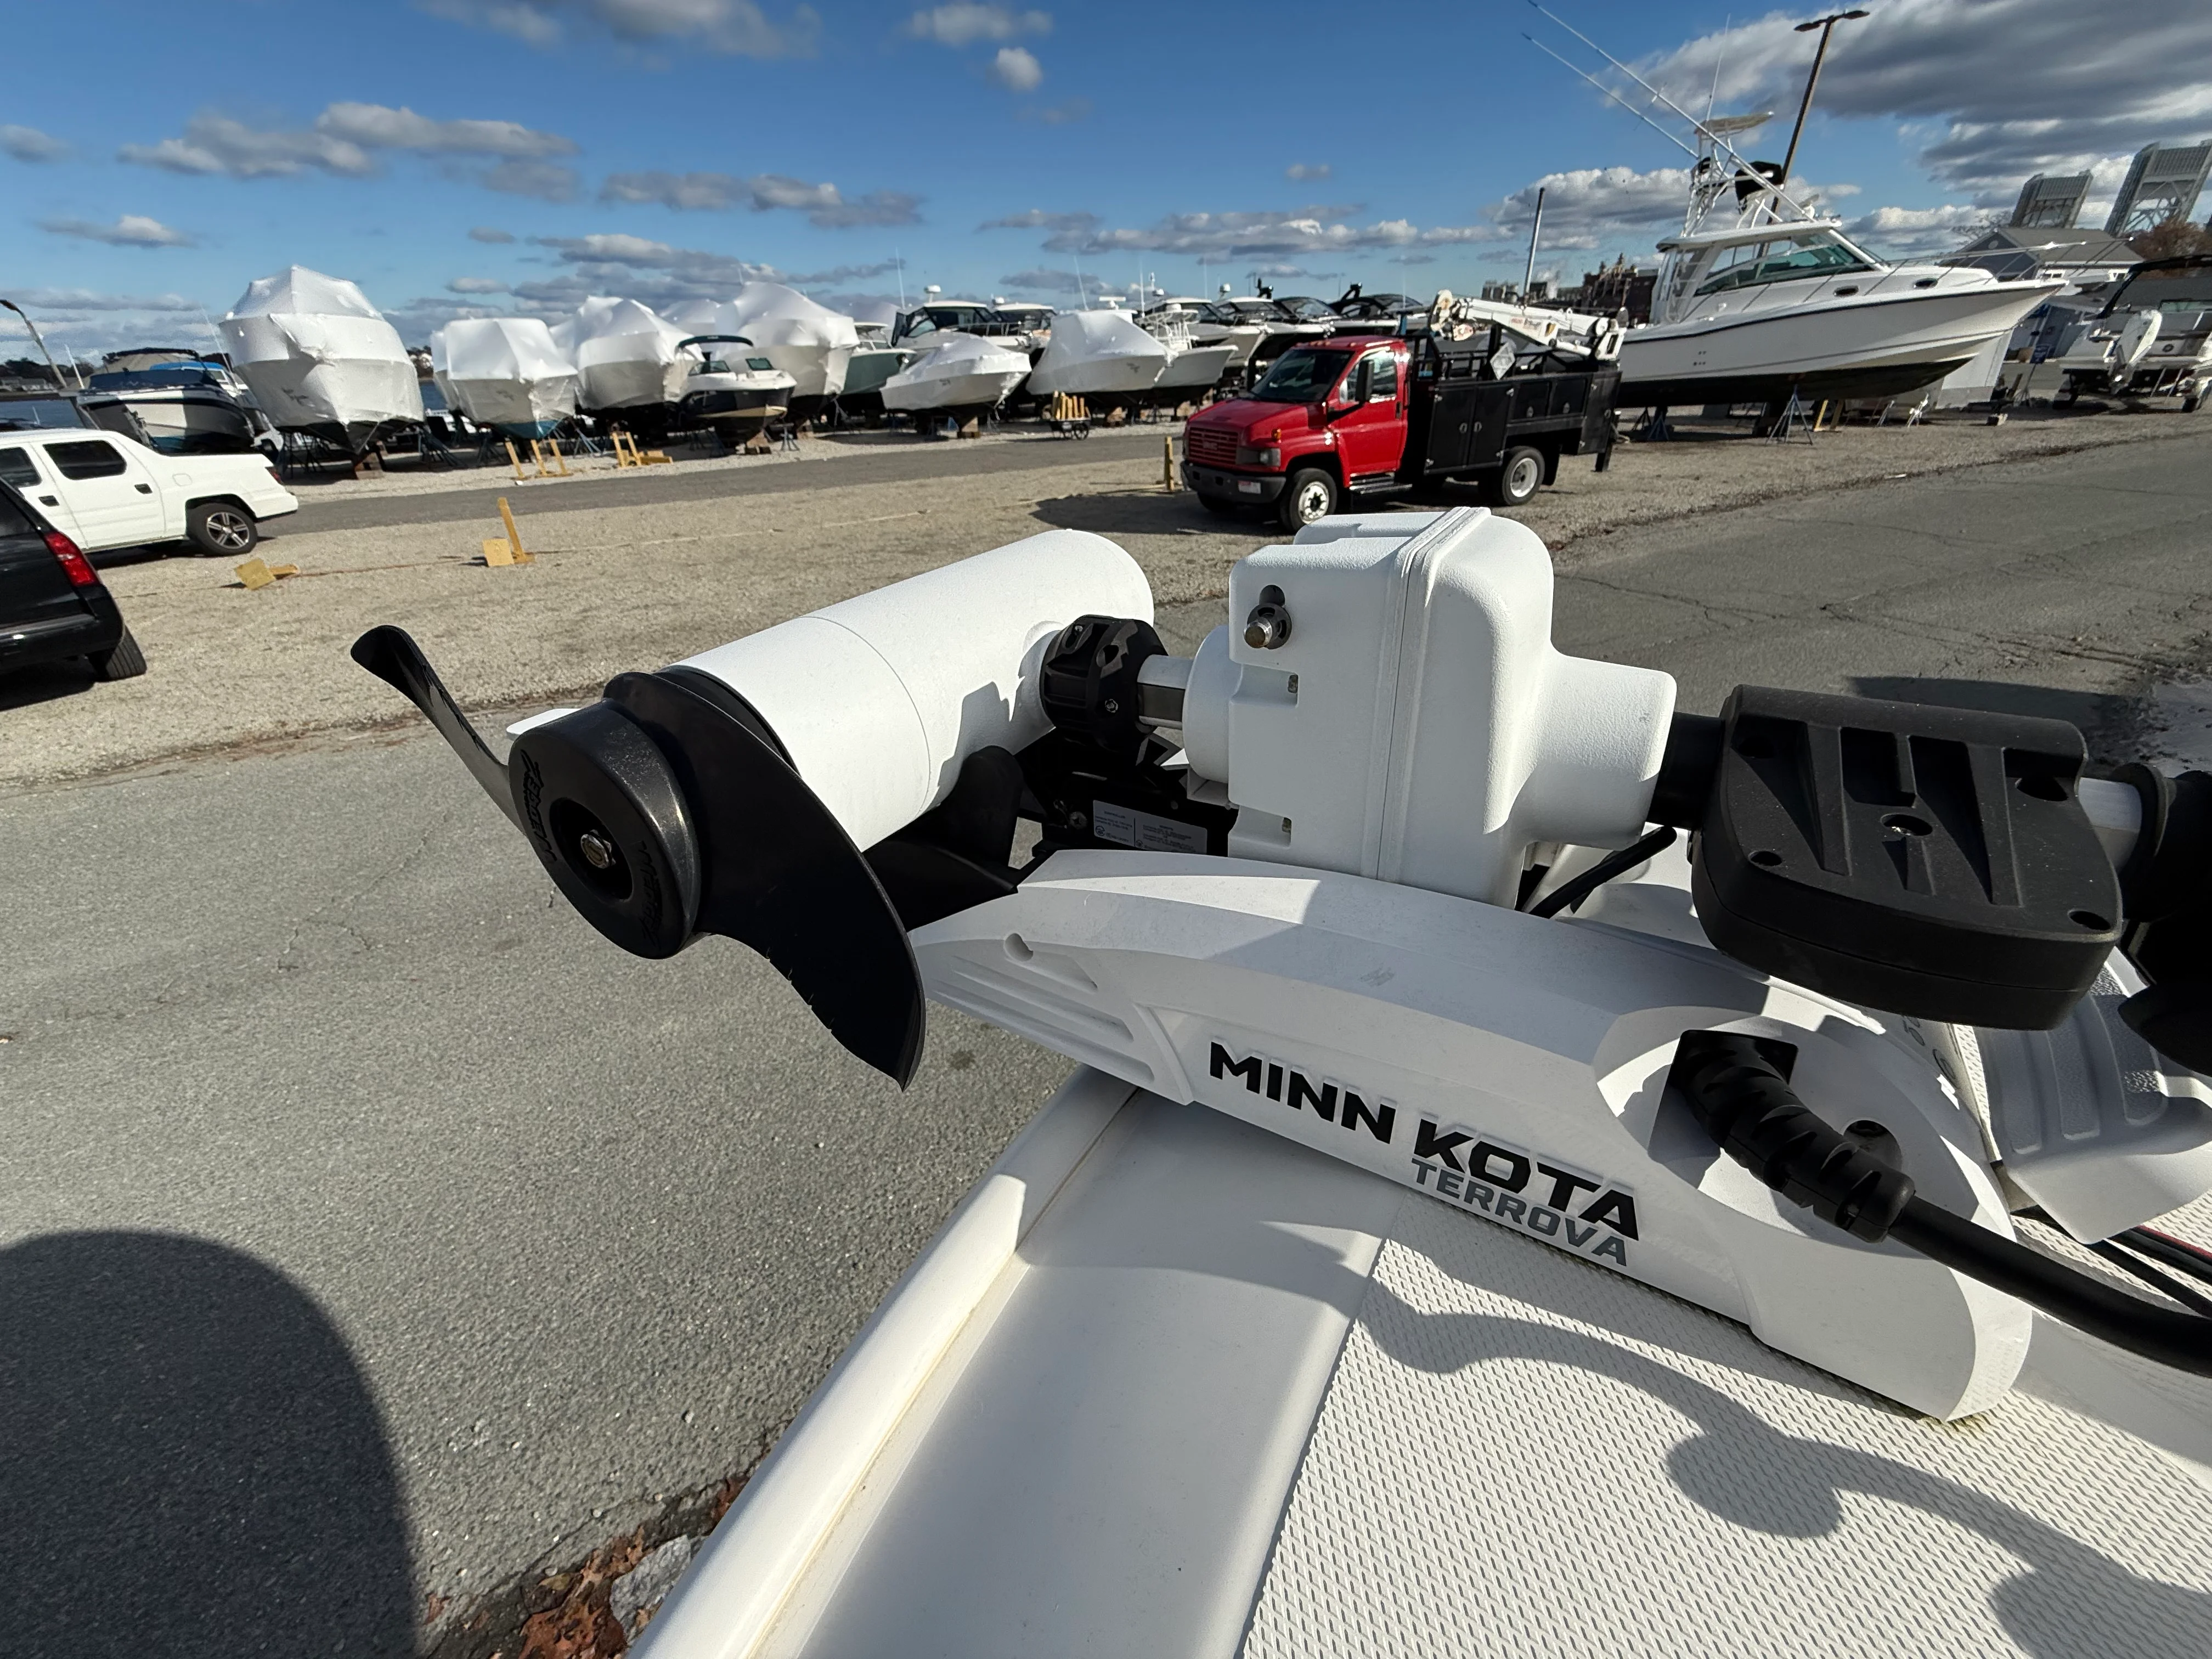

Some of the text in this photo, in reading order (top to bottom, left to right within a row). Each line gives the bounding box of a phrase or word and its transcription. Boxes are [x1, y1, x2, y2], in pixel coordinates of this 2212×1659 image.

[1210, 1041, 1639, 1241] MINN KOTA
[1412, 1158, 1627, 1266] TERROVA
